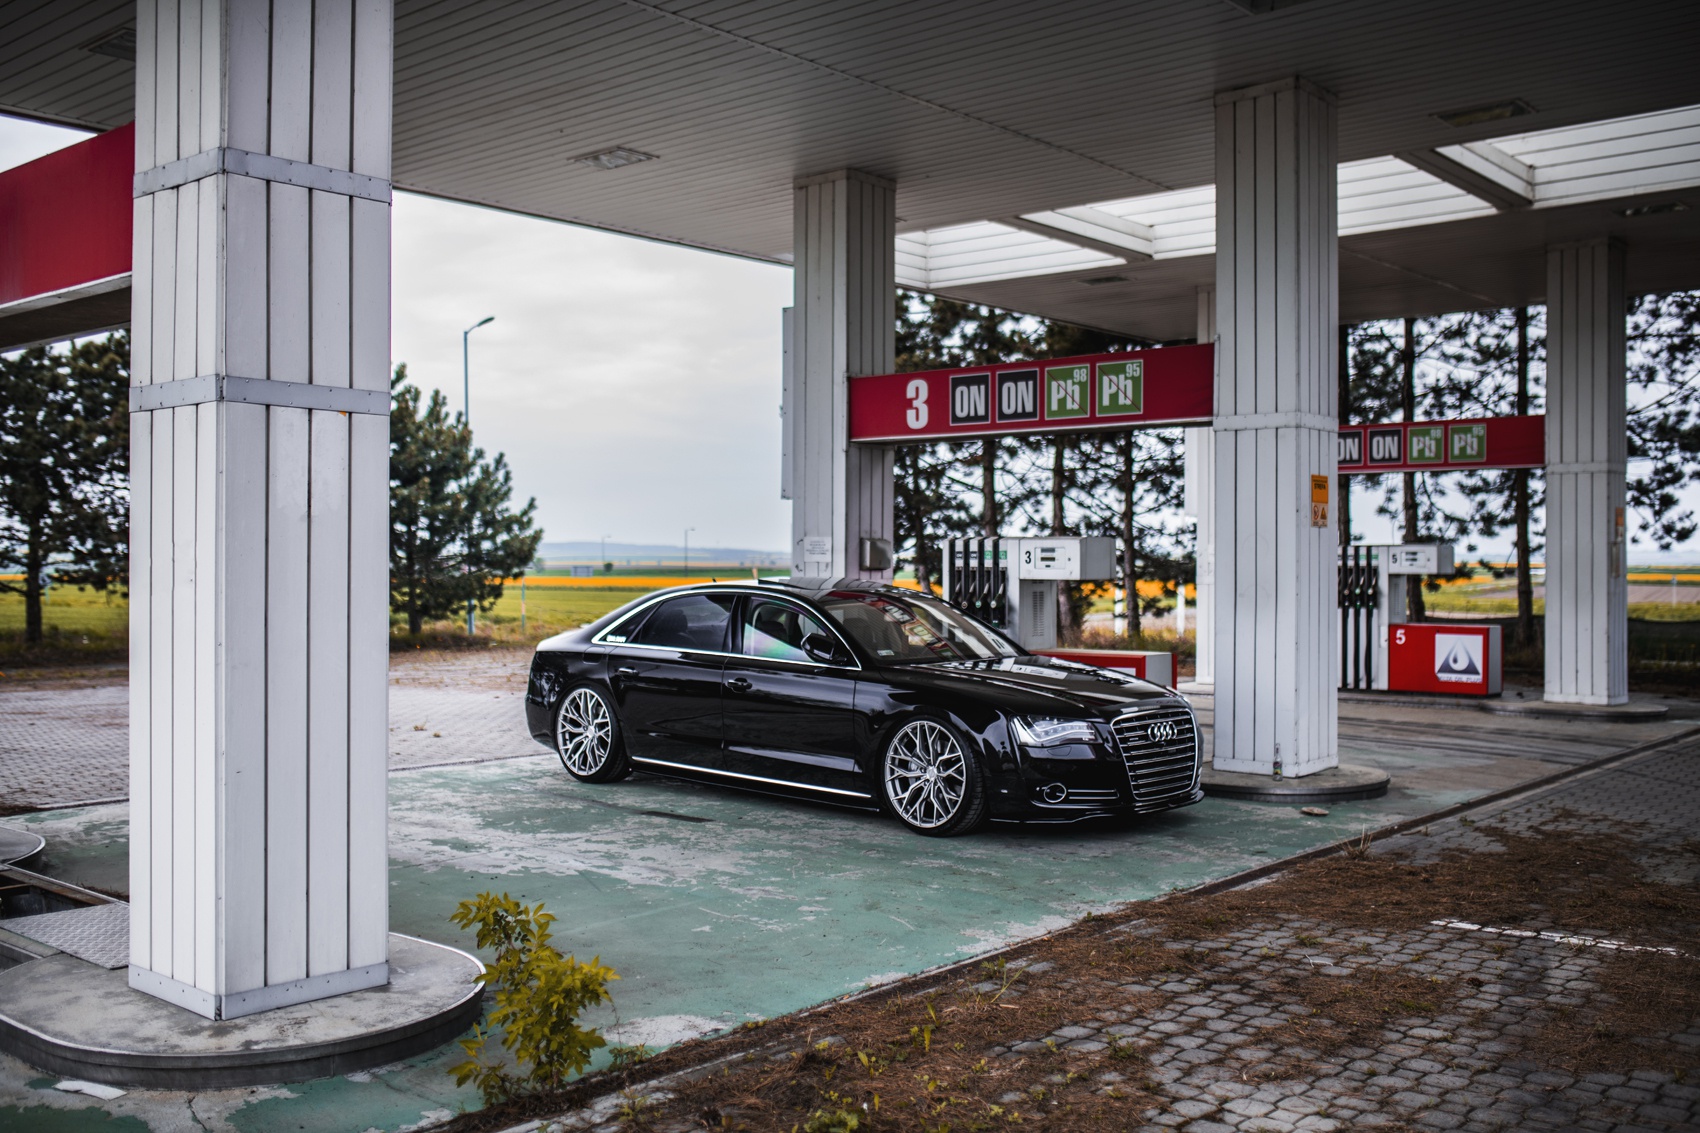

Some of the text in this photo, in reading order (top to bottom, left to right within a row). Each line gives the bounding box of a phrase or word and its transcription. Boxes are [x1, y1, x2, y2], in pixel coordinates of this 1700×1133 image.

[906, 379, 929, 430] 3
[954, 384, 985, 418] ON
[1001, 380, 1034, 415] ON
[1372, 435, 1399, 460] ON
[1024, 550, 1032, 564] 3
[1392, 554, 1398, 564] 5
[1395, 629, 1406, 645] 5
